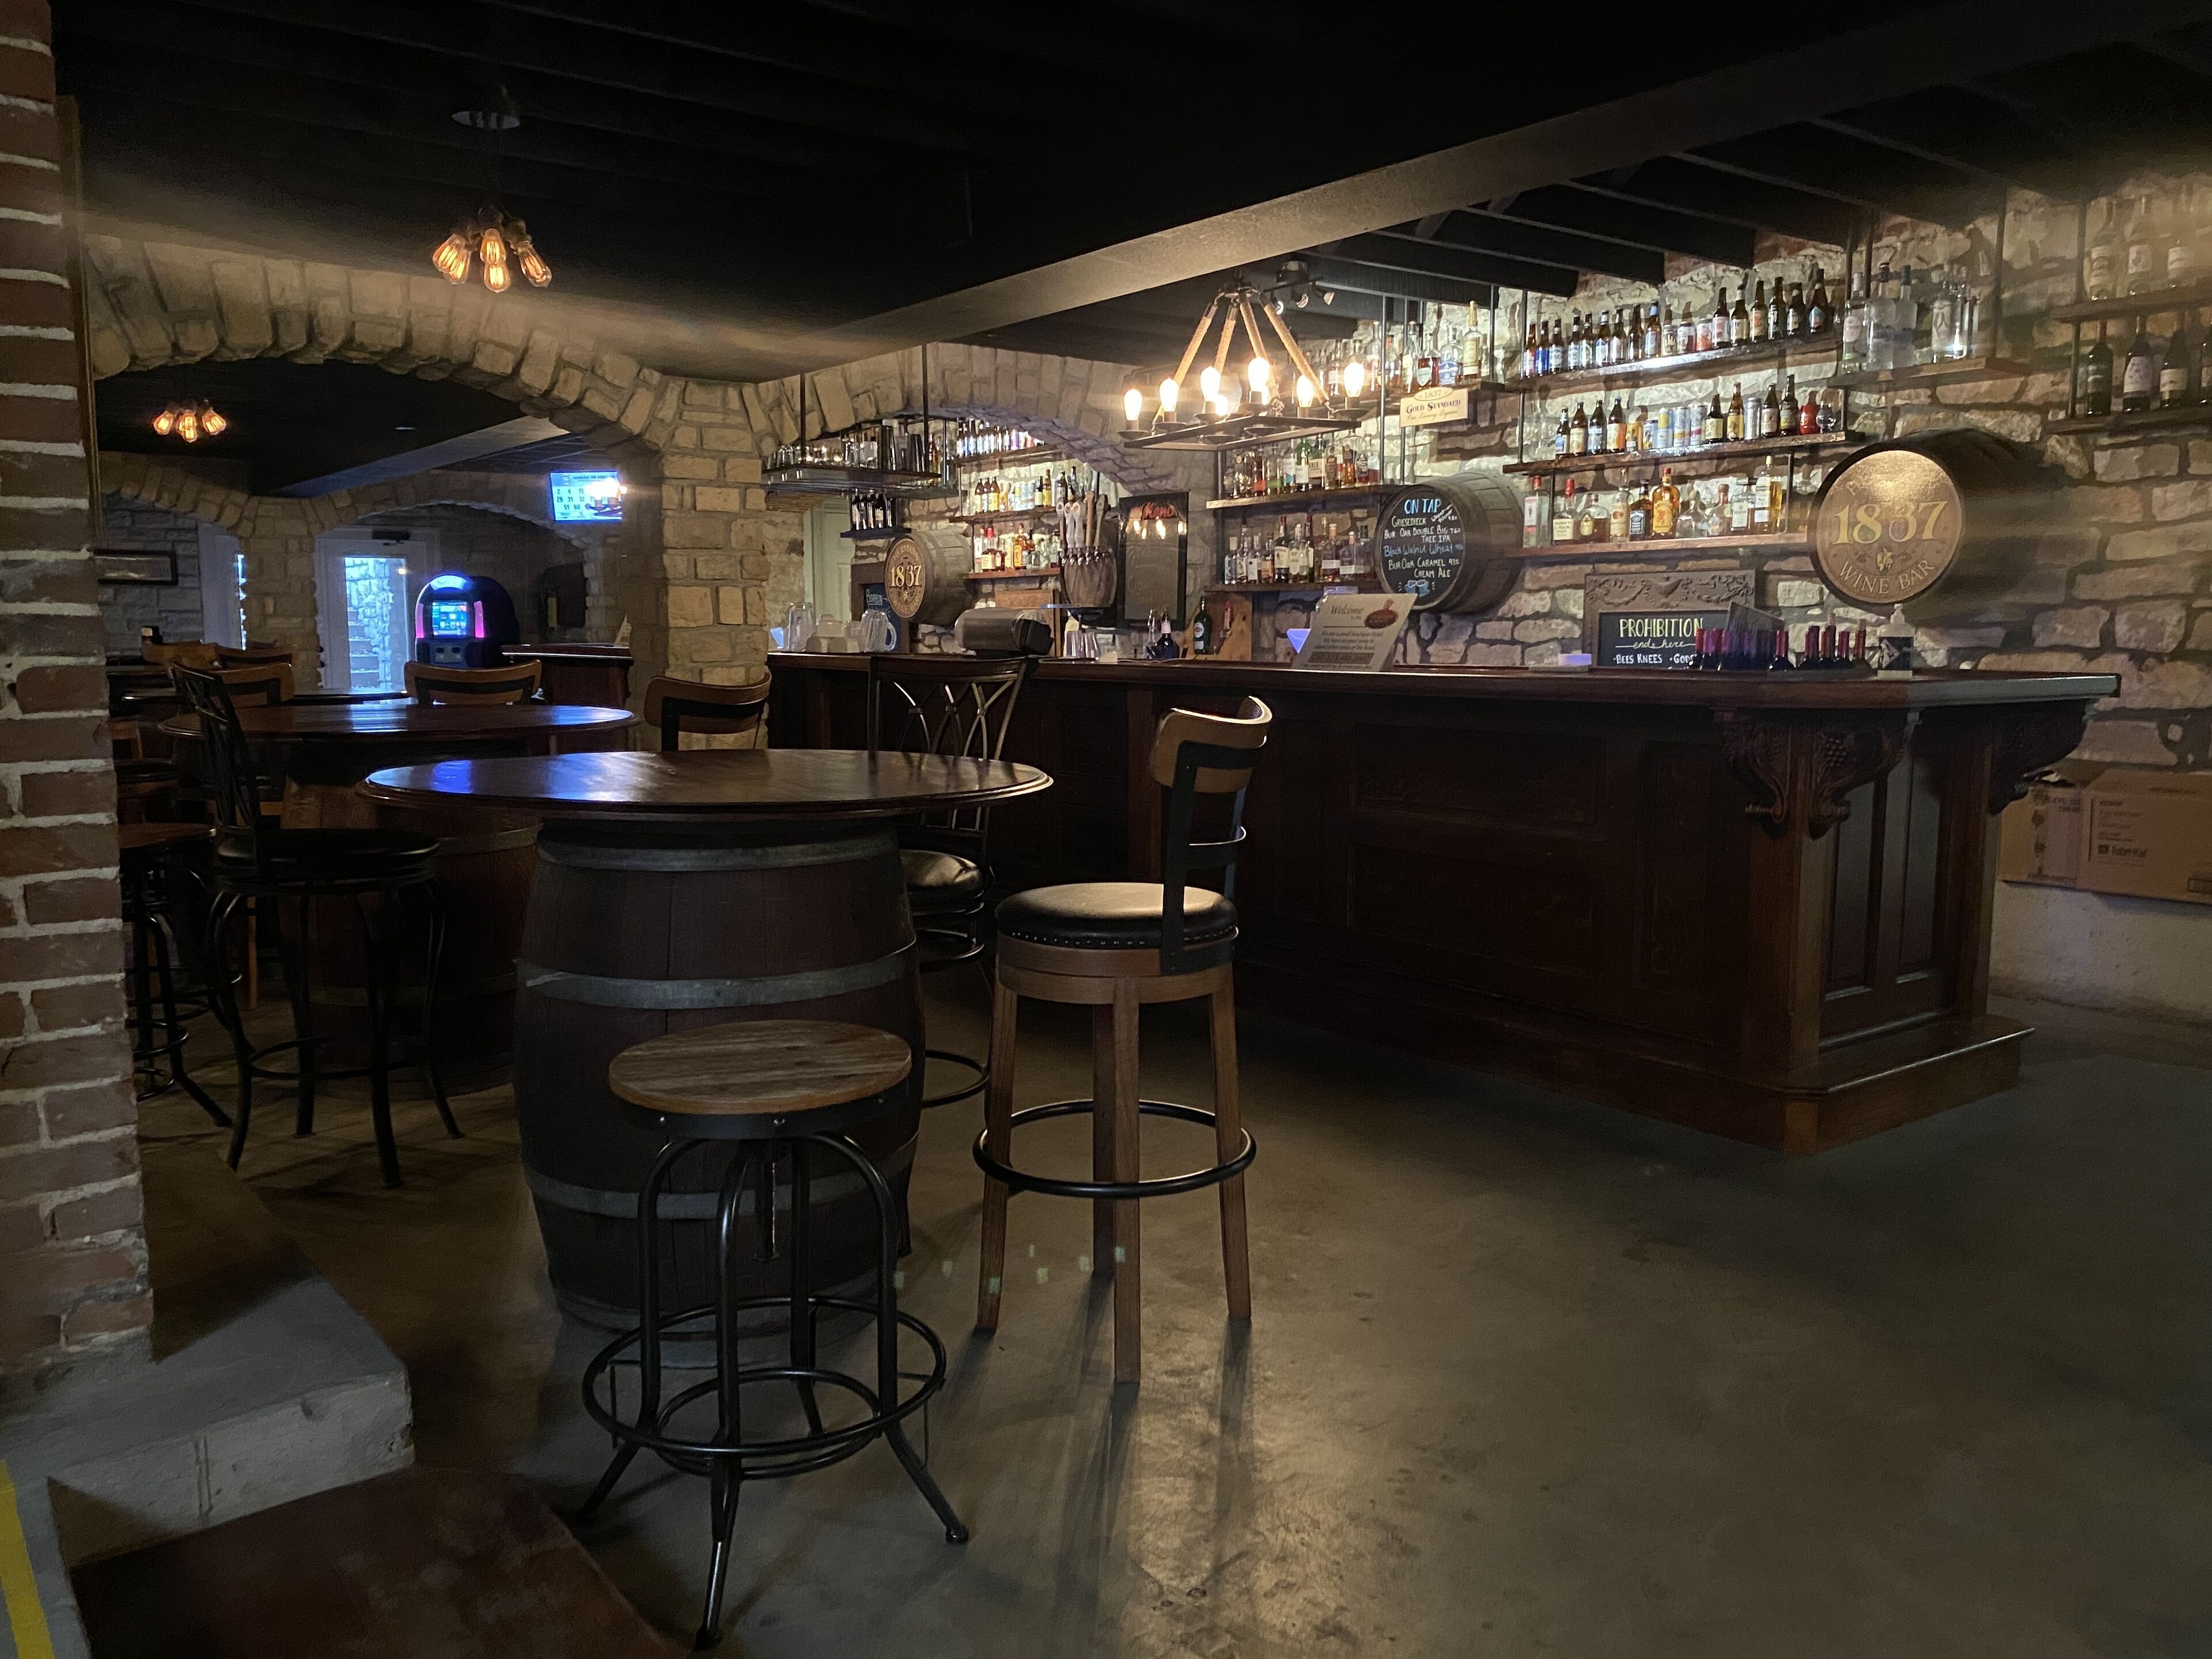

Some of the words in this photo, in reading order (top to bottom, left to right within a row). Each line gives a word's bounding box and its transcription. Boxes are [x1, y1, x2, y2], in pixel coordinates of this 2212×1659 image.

[1424, 391, 1442, 399] 1837
[1406, 405, 1425, 414] GOLD
[1427, 399, 1461, 411] STANDARD
[1404, 499, 1419, 514] ON
[1422, 499, 1442, 513] TAP
[1391, 516, 1427, 528] GRIESEDIECK
[1832, 501, 1948, 544] 1837
[1384, 529, 1396, 539] BUR
[1412, 526, 1435, 536] DOUBLE
[1437, 524, 1448, 535] BIG
[1421, 535, 1437, 543] TREE
[1438, 535, 1451, 543] IPA
[1383, 545, 1402, 557] Black
[1403, 543, 1427, 555] Walnut
[1429, 542, 1453, 554] Wheat
[1417, 557, 1446, 567] CARAMEL
[891, 565, 922, 587] 1837
[1414, 568, 1435, 578] CREAM
[1438, 567, 1451, 578] ALE
[1839, 561, 1890, 594] WINE
[1898, 559, 1935, 590] BAR
[1331, 604, 1364, 615] Welcome
[1619, 618, 1703, 637] PROHIBITION
[1633, 638, 1656, 649] ends
[1661, 639, 1684, 648] here
[1616, 654, 1634, 664] BEES
[1637, 653, 1662, 664] KNEES
